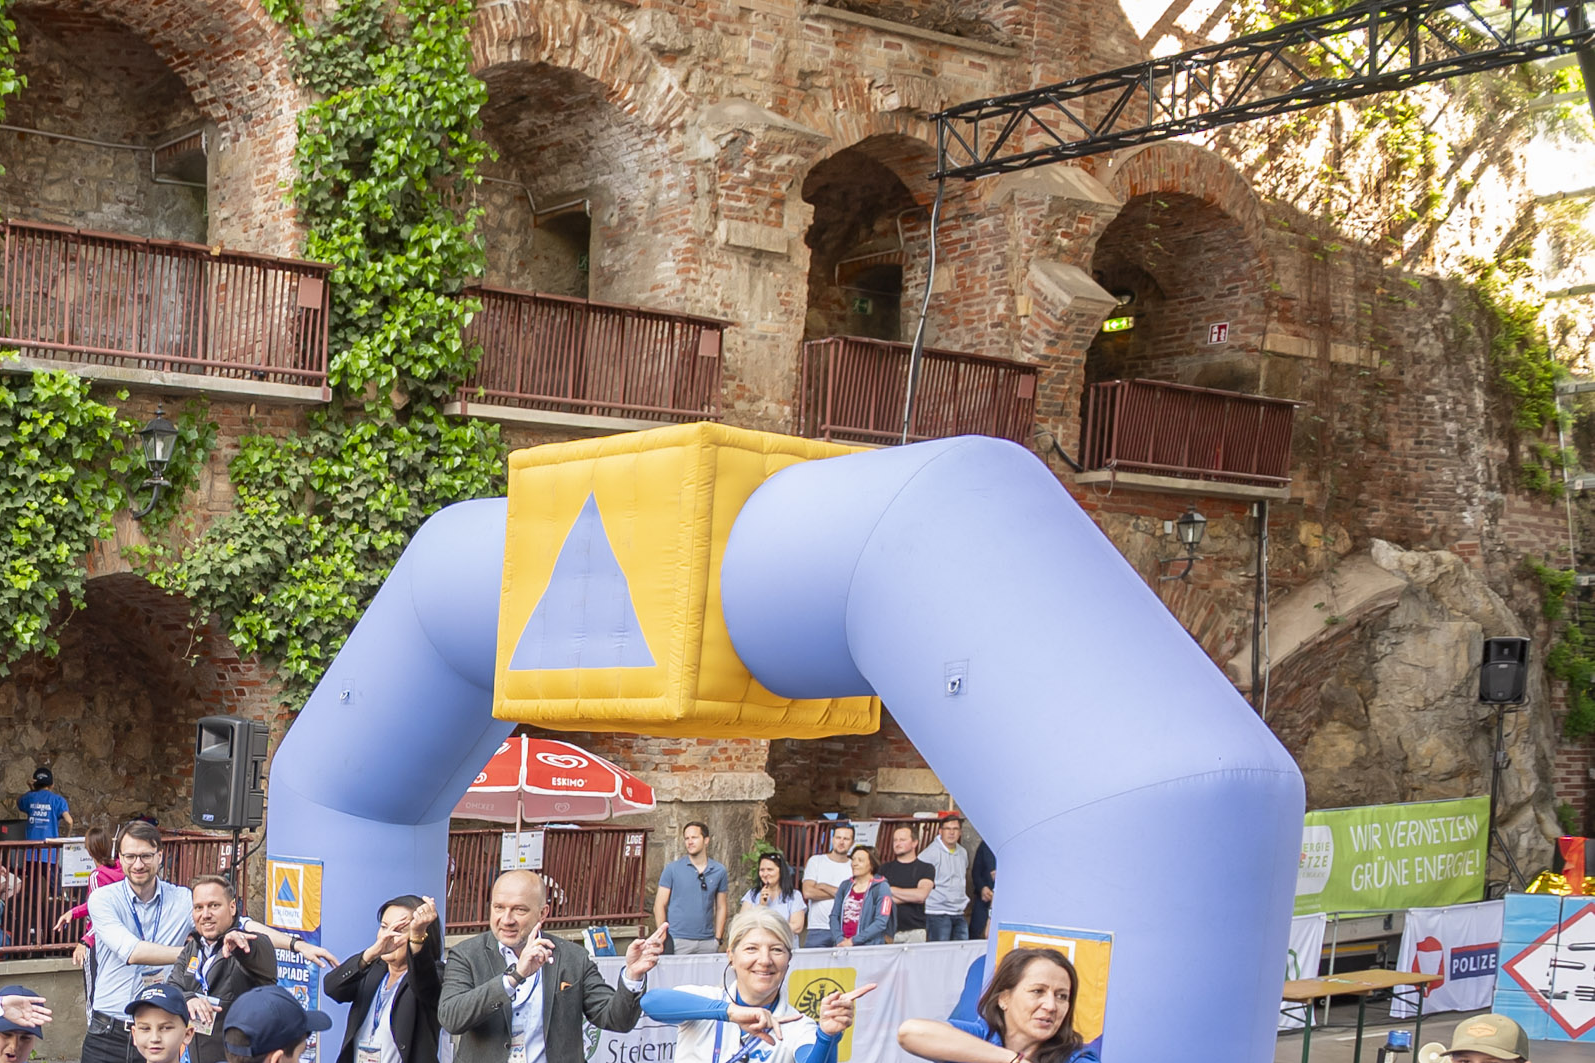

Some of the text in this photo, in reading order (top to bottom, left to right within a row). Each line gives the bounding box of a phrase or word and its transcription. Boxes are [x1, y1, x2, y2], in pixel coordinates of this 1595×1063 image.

[551, 776, 585, 788] ESKIMO
[1350, 813, 1478, 853] WIR VERNETZEN
[626, 834, 643, 845] LOGE
[625, 846, 631, 856] 2
[1302, 842, 1331, 853] ERGIE
[220, 858, 227, 869] 3
[1350, 848, 1481, 892] GRÜNE ENERGIE!
[1452, 953, 1497, 974] POLIZE
